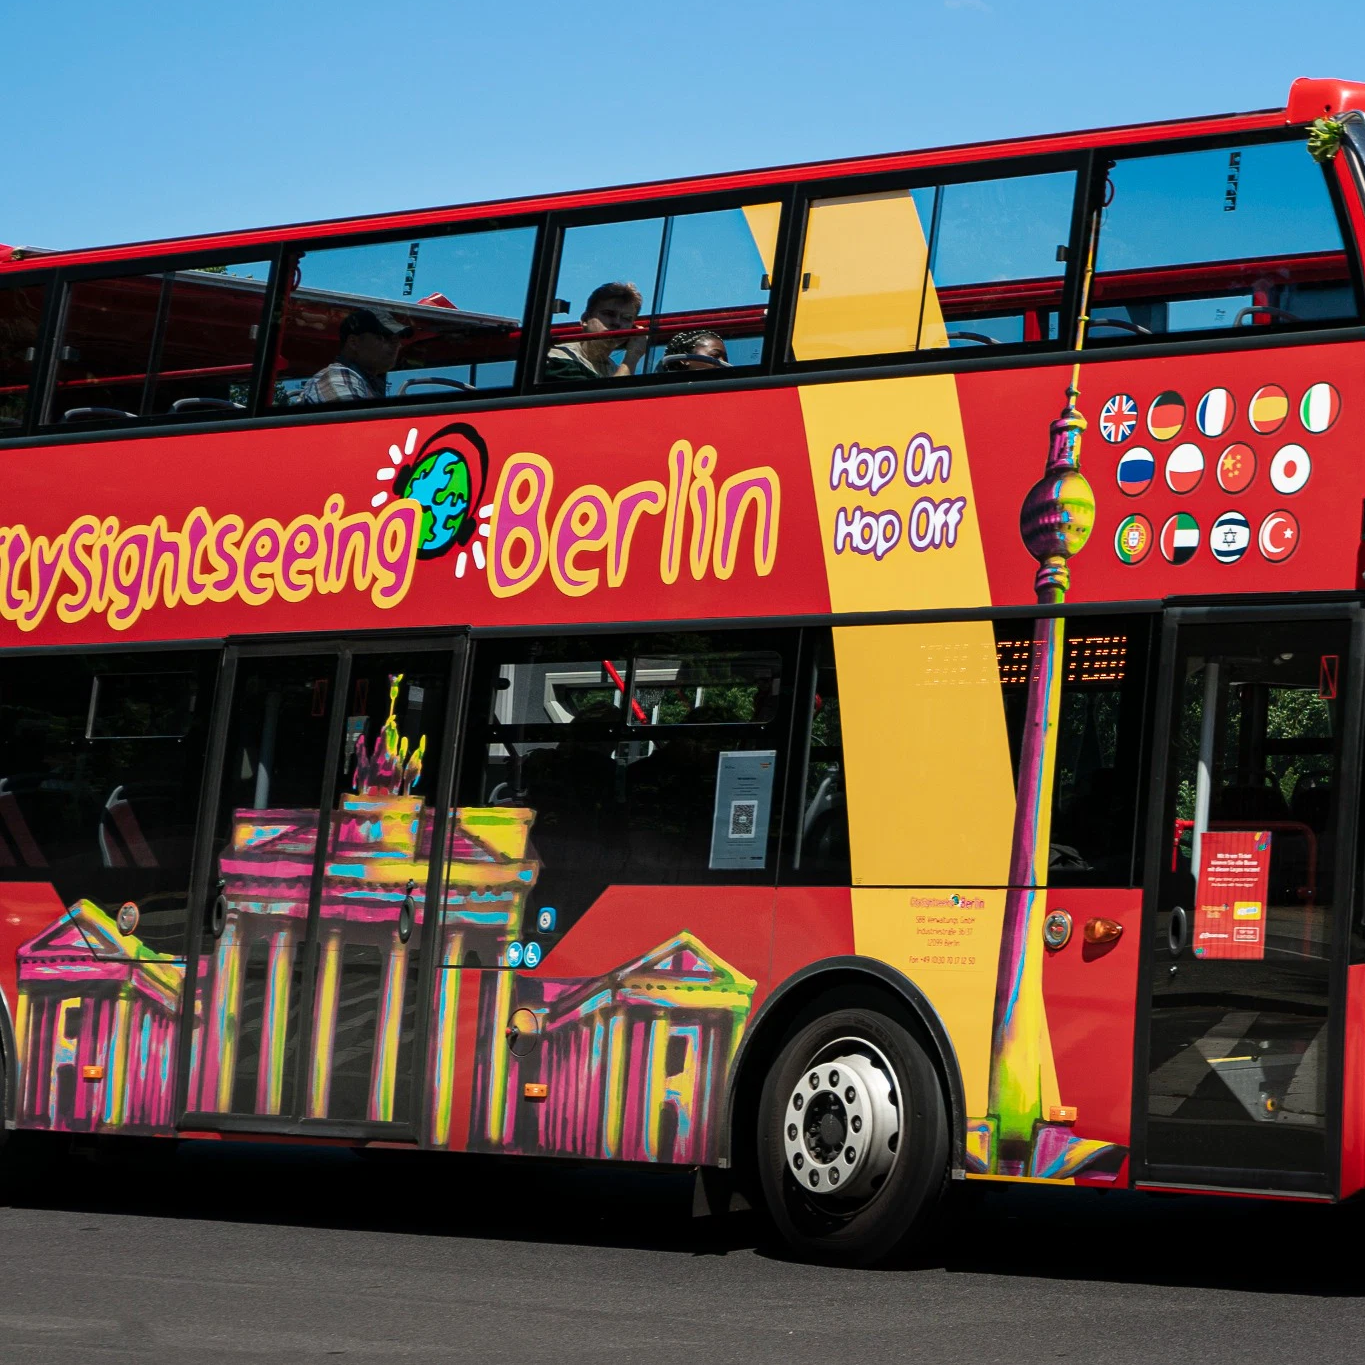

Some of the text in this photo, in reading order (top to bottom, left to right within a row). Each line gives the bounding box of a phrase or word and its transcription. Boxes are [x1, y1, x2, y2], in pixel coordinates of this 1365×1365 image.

[830, 432, 952, 496] Hop On
[487, 439, 780, 598] Berlin
[834, 496, 967, 561] Hop Off
